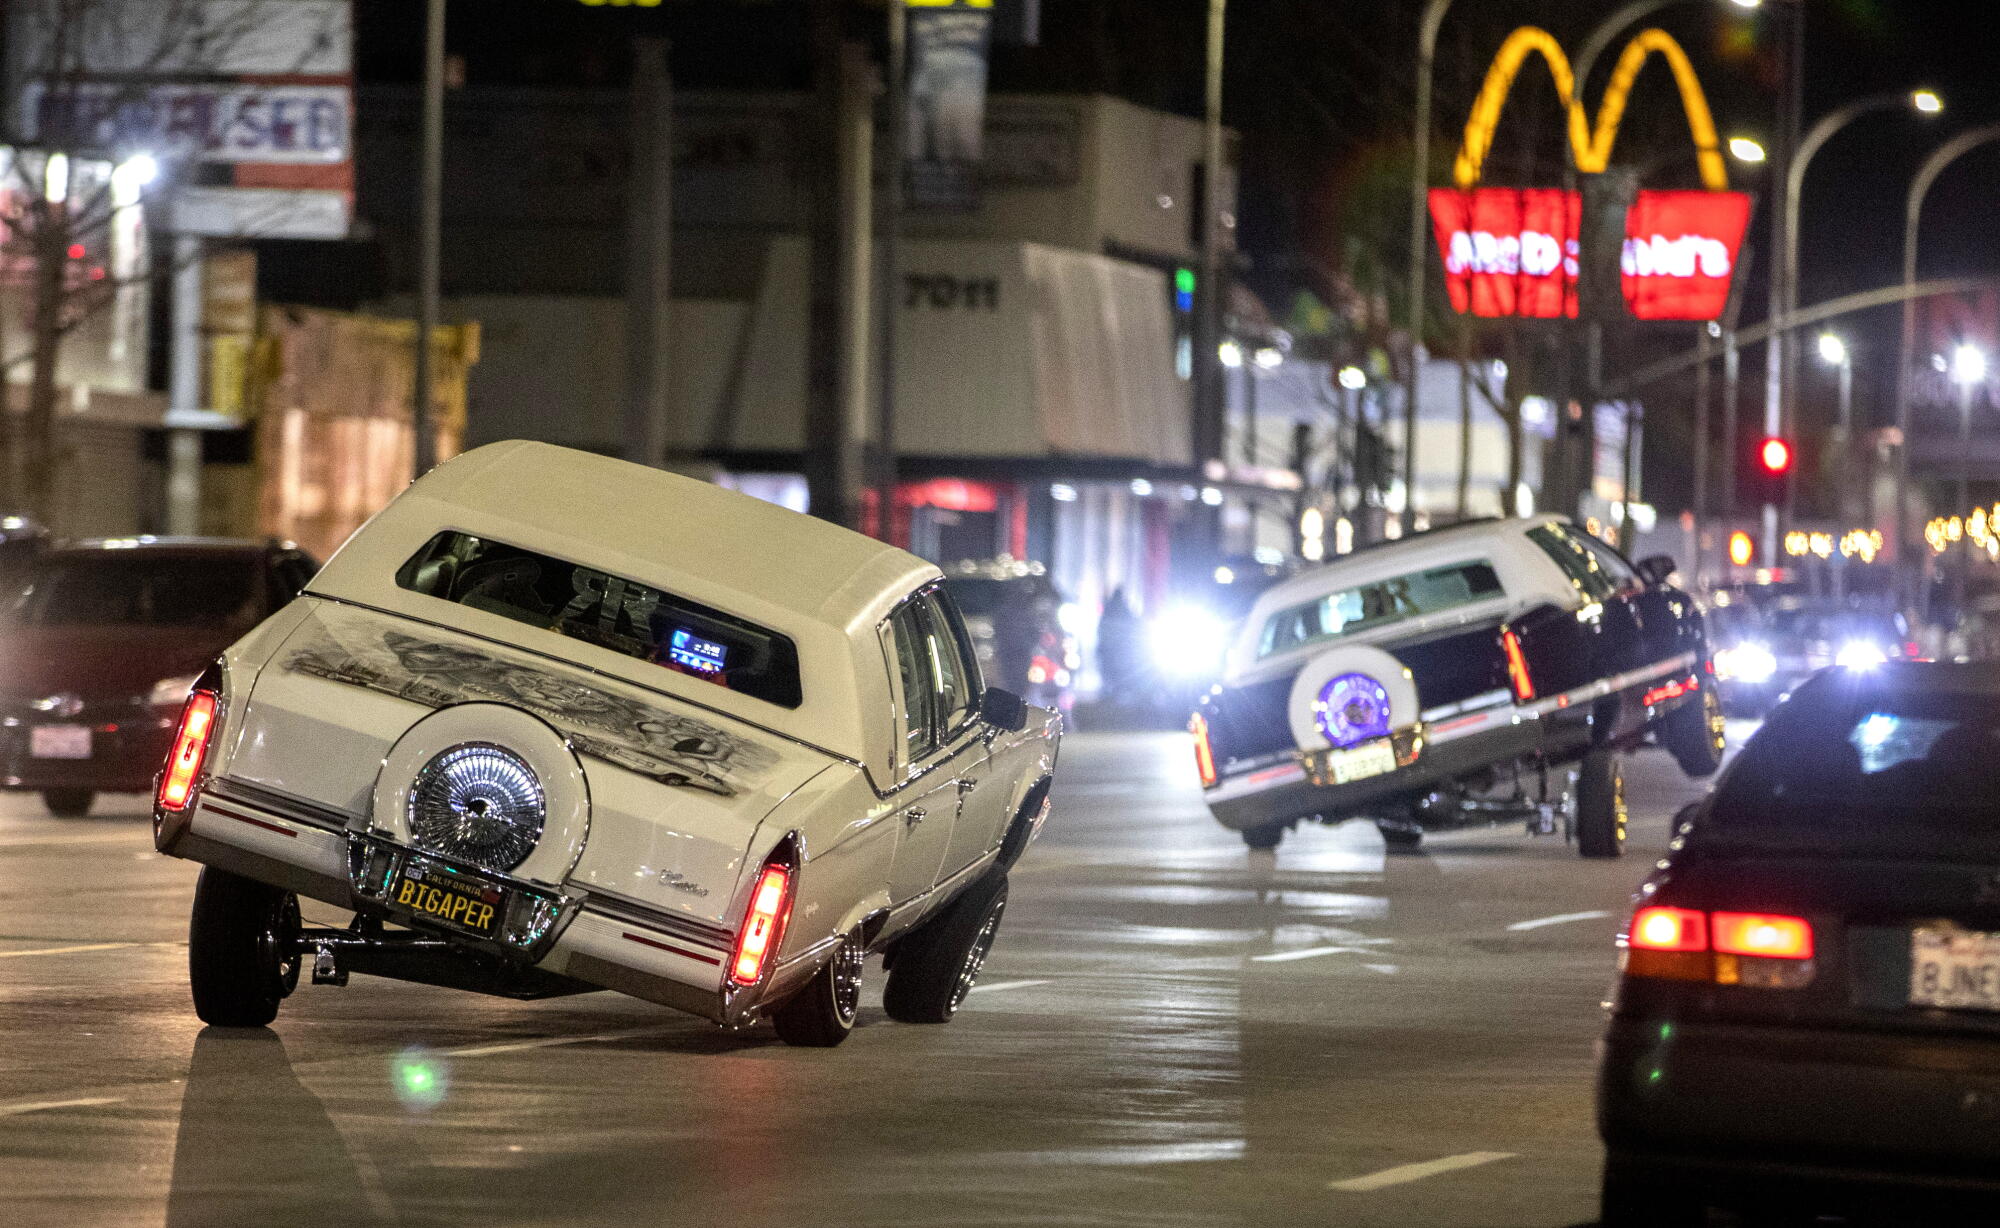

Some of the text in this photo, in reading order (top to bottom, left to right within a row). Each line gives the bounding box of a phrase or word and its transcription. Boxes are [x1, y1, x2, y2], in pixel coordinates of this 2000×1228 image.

[1446, 230, 1730, 278] McDald's
[903, 272, 1000, 311] 7011
[397, 879, 495, 929] BIGAPER
[425, 873, 481, 896] CALIFORNIA
